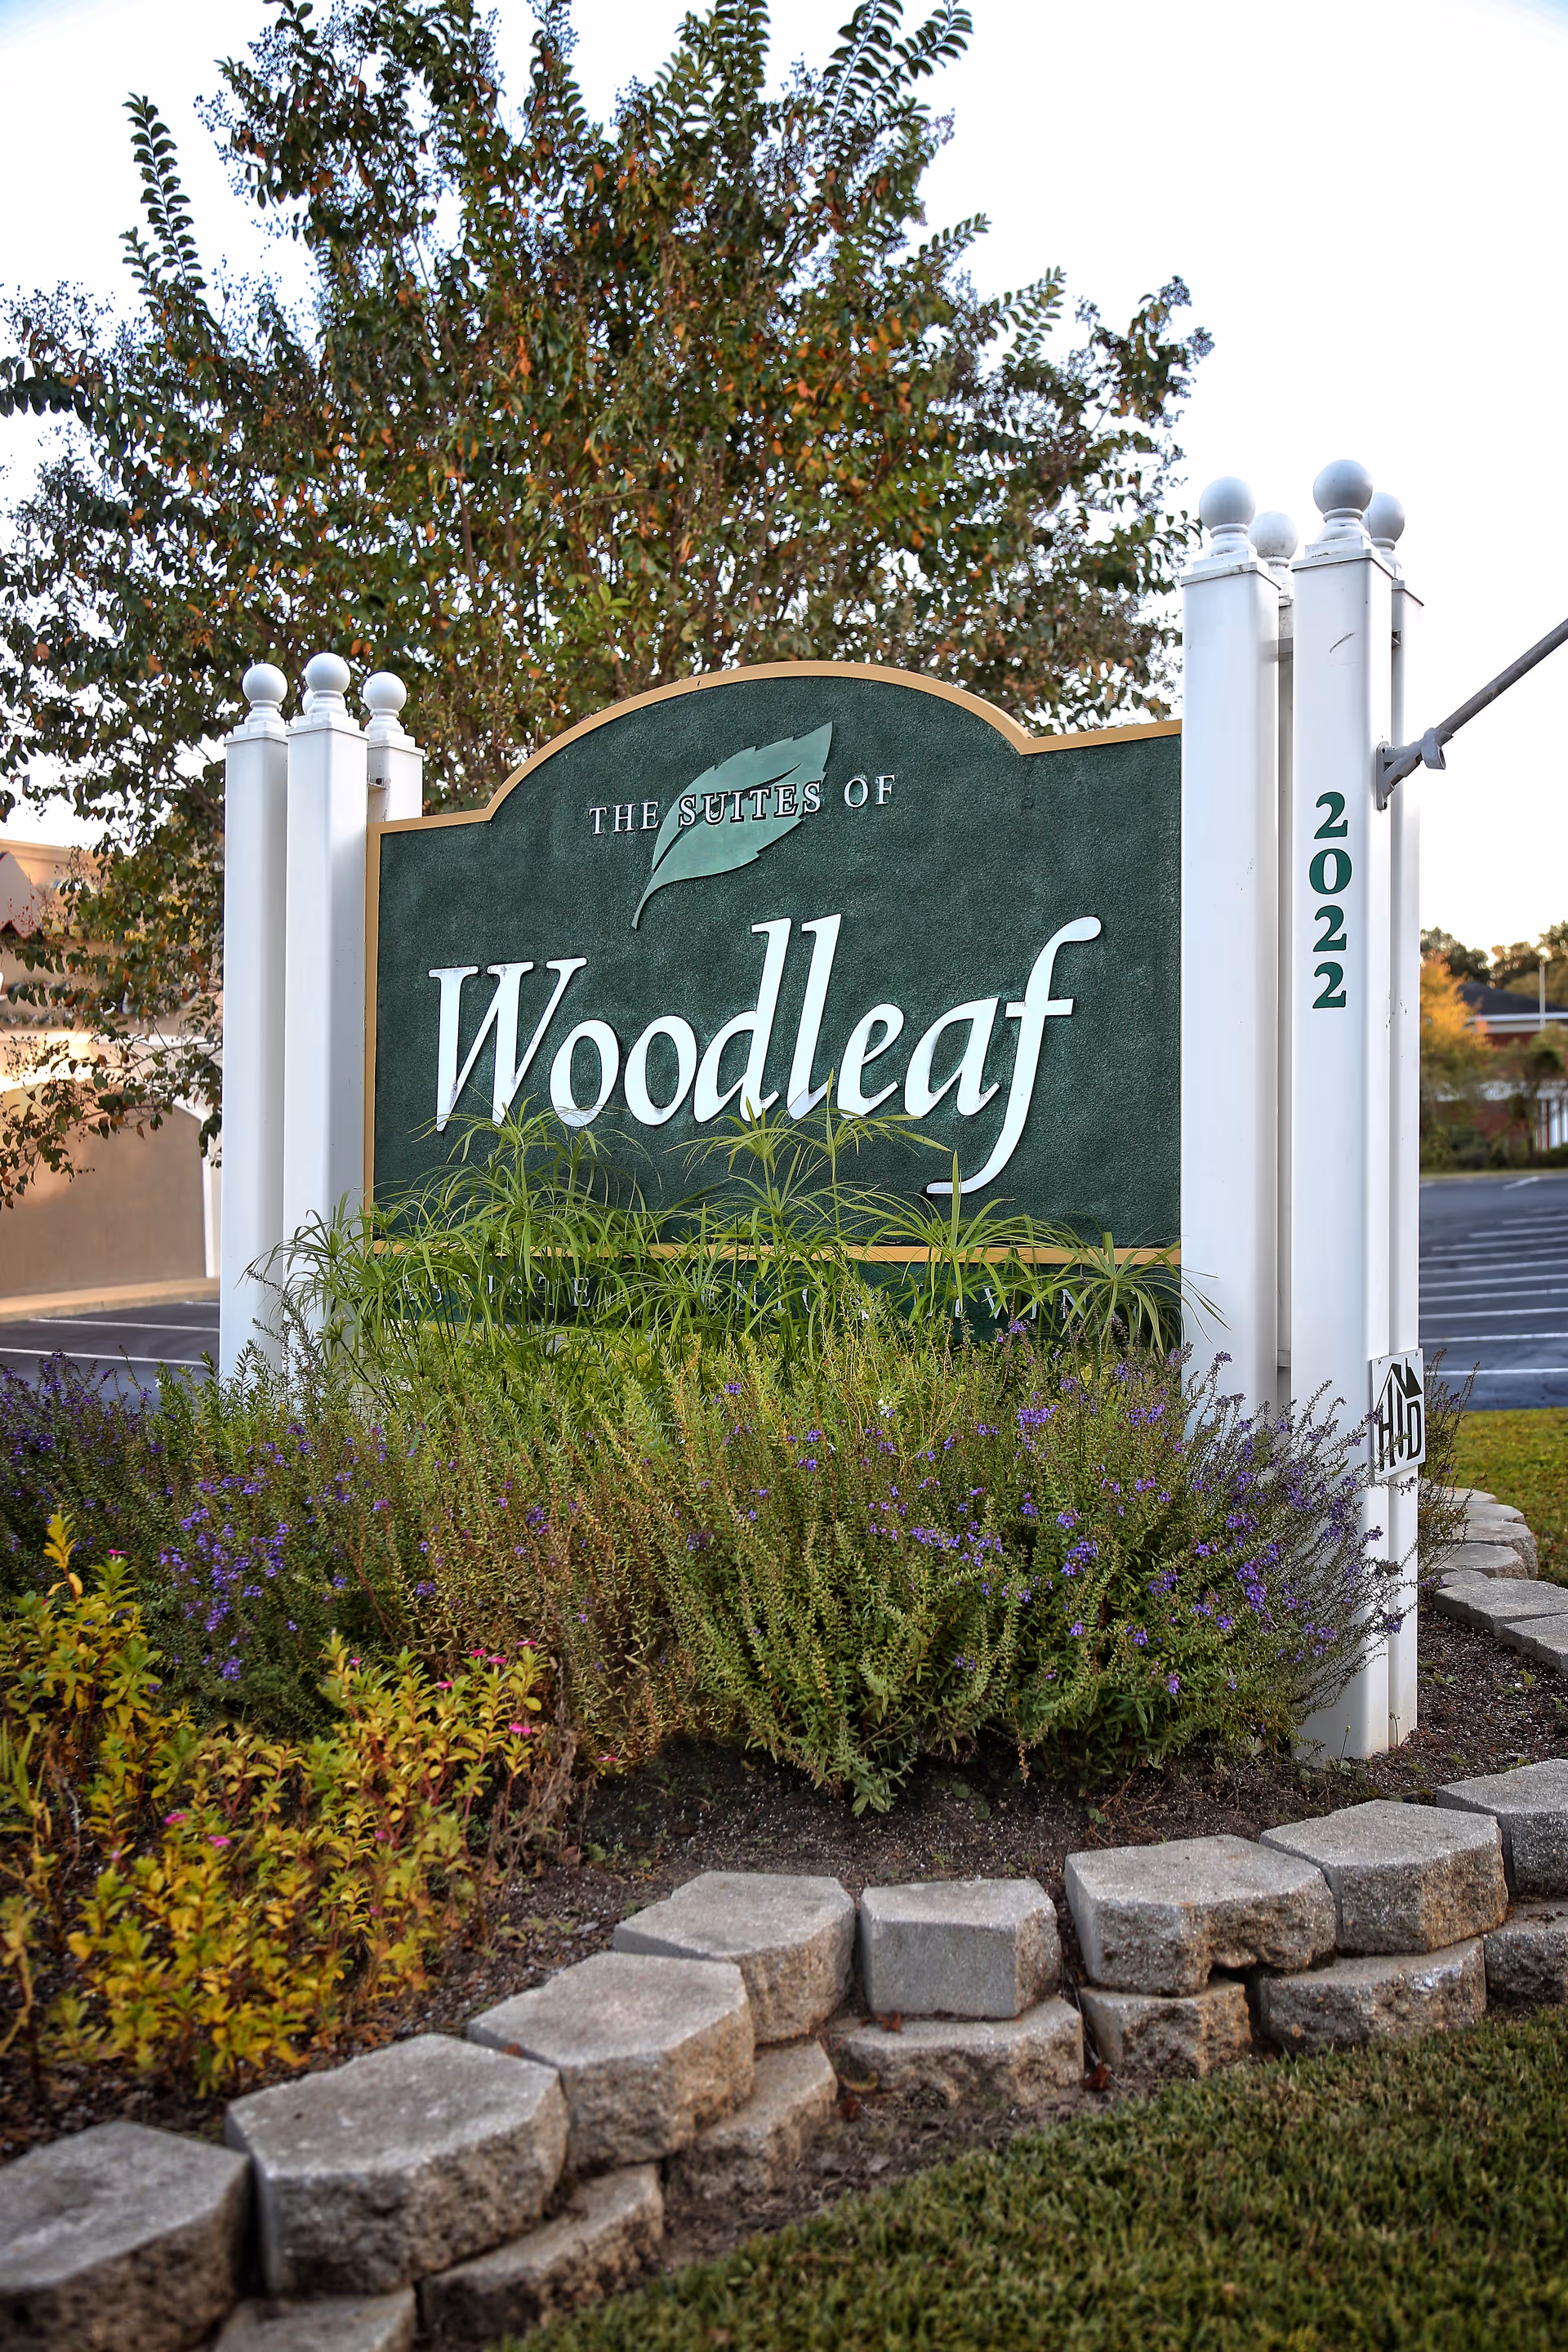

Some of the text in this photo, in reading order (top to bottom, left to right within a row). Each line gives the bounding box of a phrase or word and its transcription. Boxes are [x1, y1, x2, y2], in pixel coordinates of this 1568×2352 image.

[589, 774, 896, 835] THE SUITES OF
[1308, 791, 1352, 1009] 2022
[428, 913, 1102, 1195] Woodleaf
